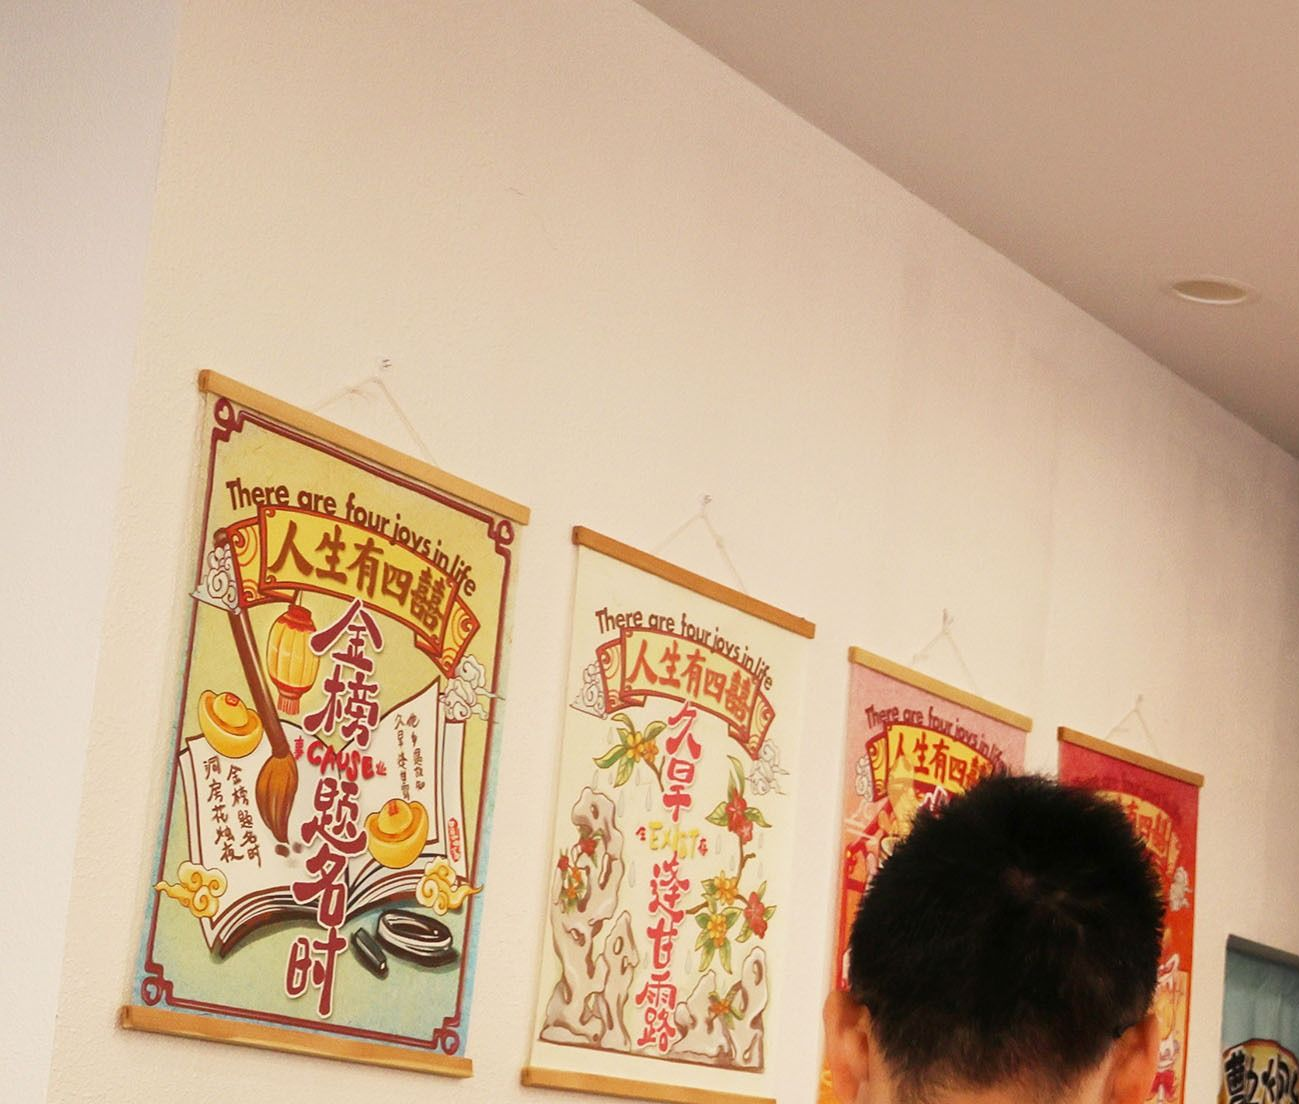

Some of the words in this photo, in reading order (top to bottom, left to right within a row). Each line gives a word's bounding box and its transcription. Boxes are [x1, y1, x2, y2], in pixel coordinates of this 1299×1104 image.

[226, 477, 289, 511] There
[297, 489, 337, 515] are
[345, 492, 390, 533] four
[389, 513, 431, 552] joys
[434, 540, 450, 574] in
[449, 554, 477, 597] life
[595, 607, 643, 634] There
[648, 613, 675, 632] are
[681, 612, 712, 644] four
[711, 627, 740, 660] joys
[743, 646, 753, 671] in
[753, 657, 773, 690] life
[307, 740, 376, 782] CAUSE
[864, 704, 899, 729] There
[903, 707, 924, 725] are
[928, 706, 953, 737] four
[286, 599, 382, 1017] 金榜题名时
